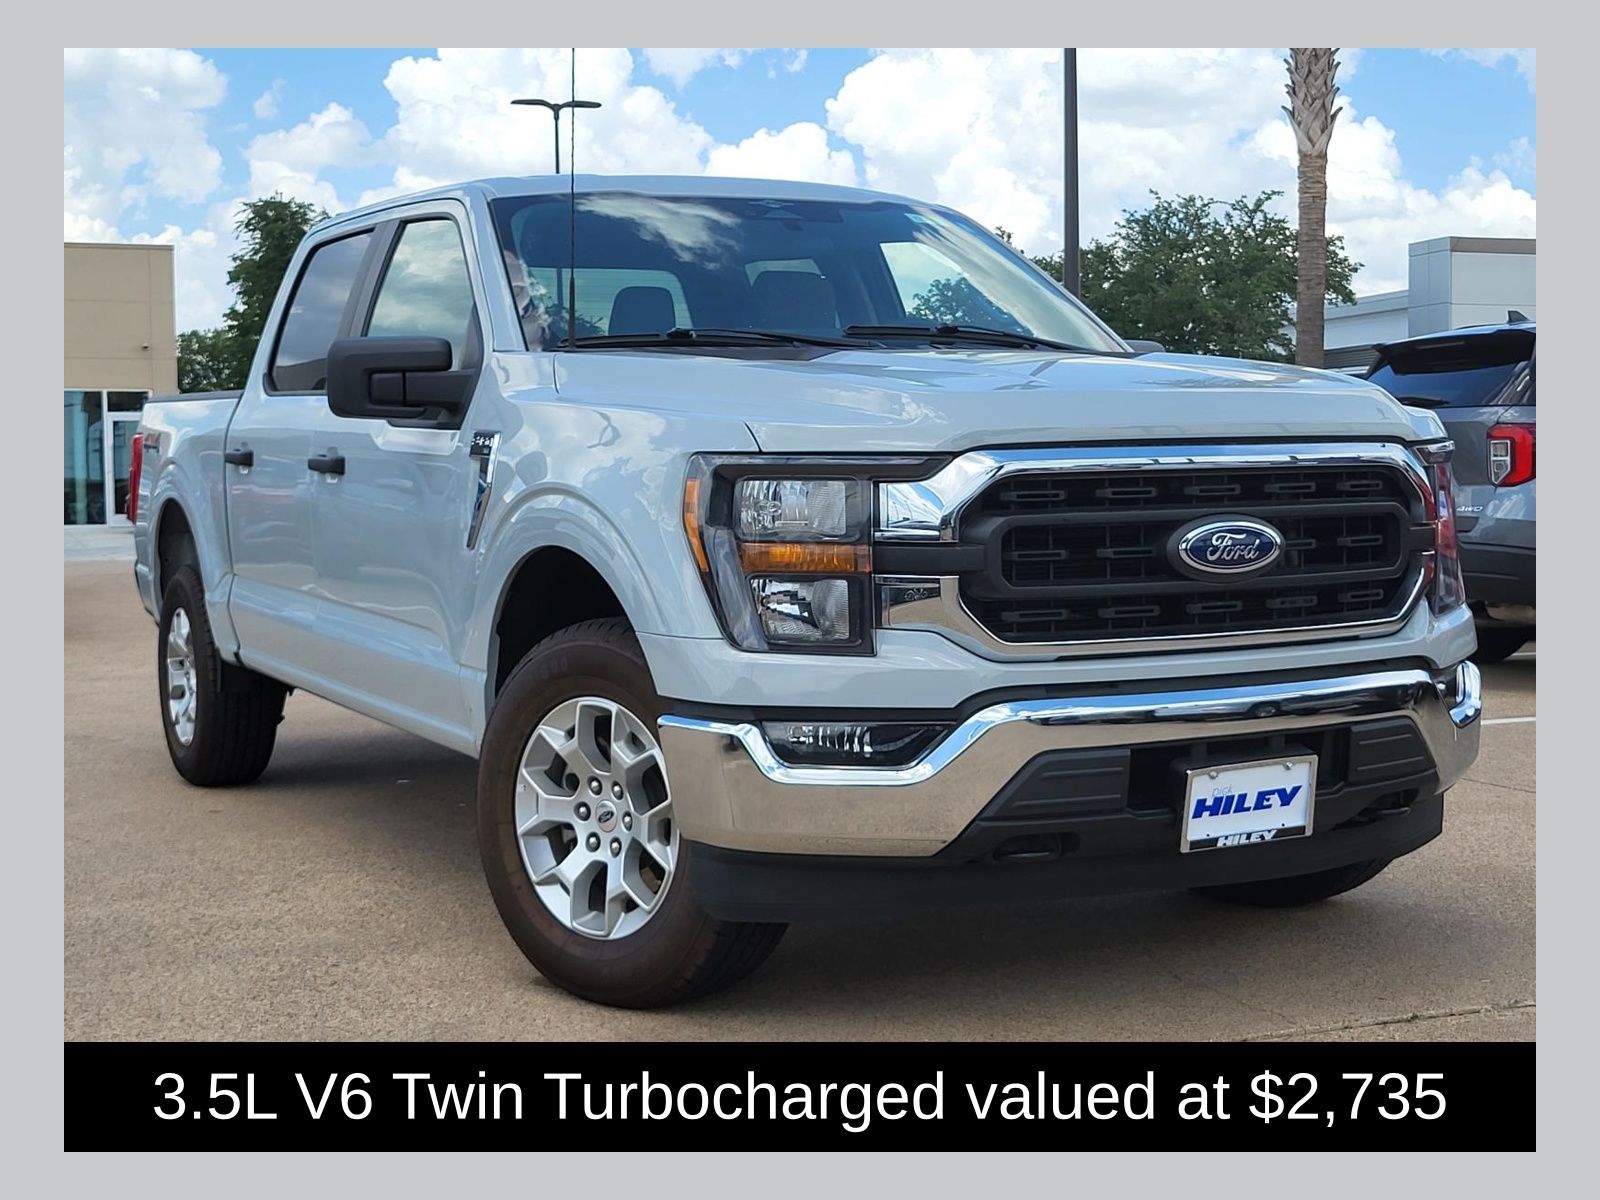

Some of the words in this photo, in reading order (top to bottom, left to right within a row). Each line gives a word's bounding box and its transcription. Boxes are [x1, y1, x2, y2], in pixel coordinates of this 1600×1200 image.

[1206, 532, 1260, 561] Ford
[1192, 785, 1303, 820] HILEY
[1217, 829, 1277, 847] HILEY
